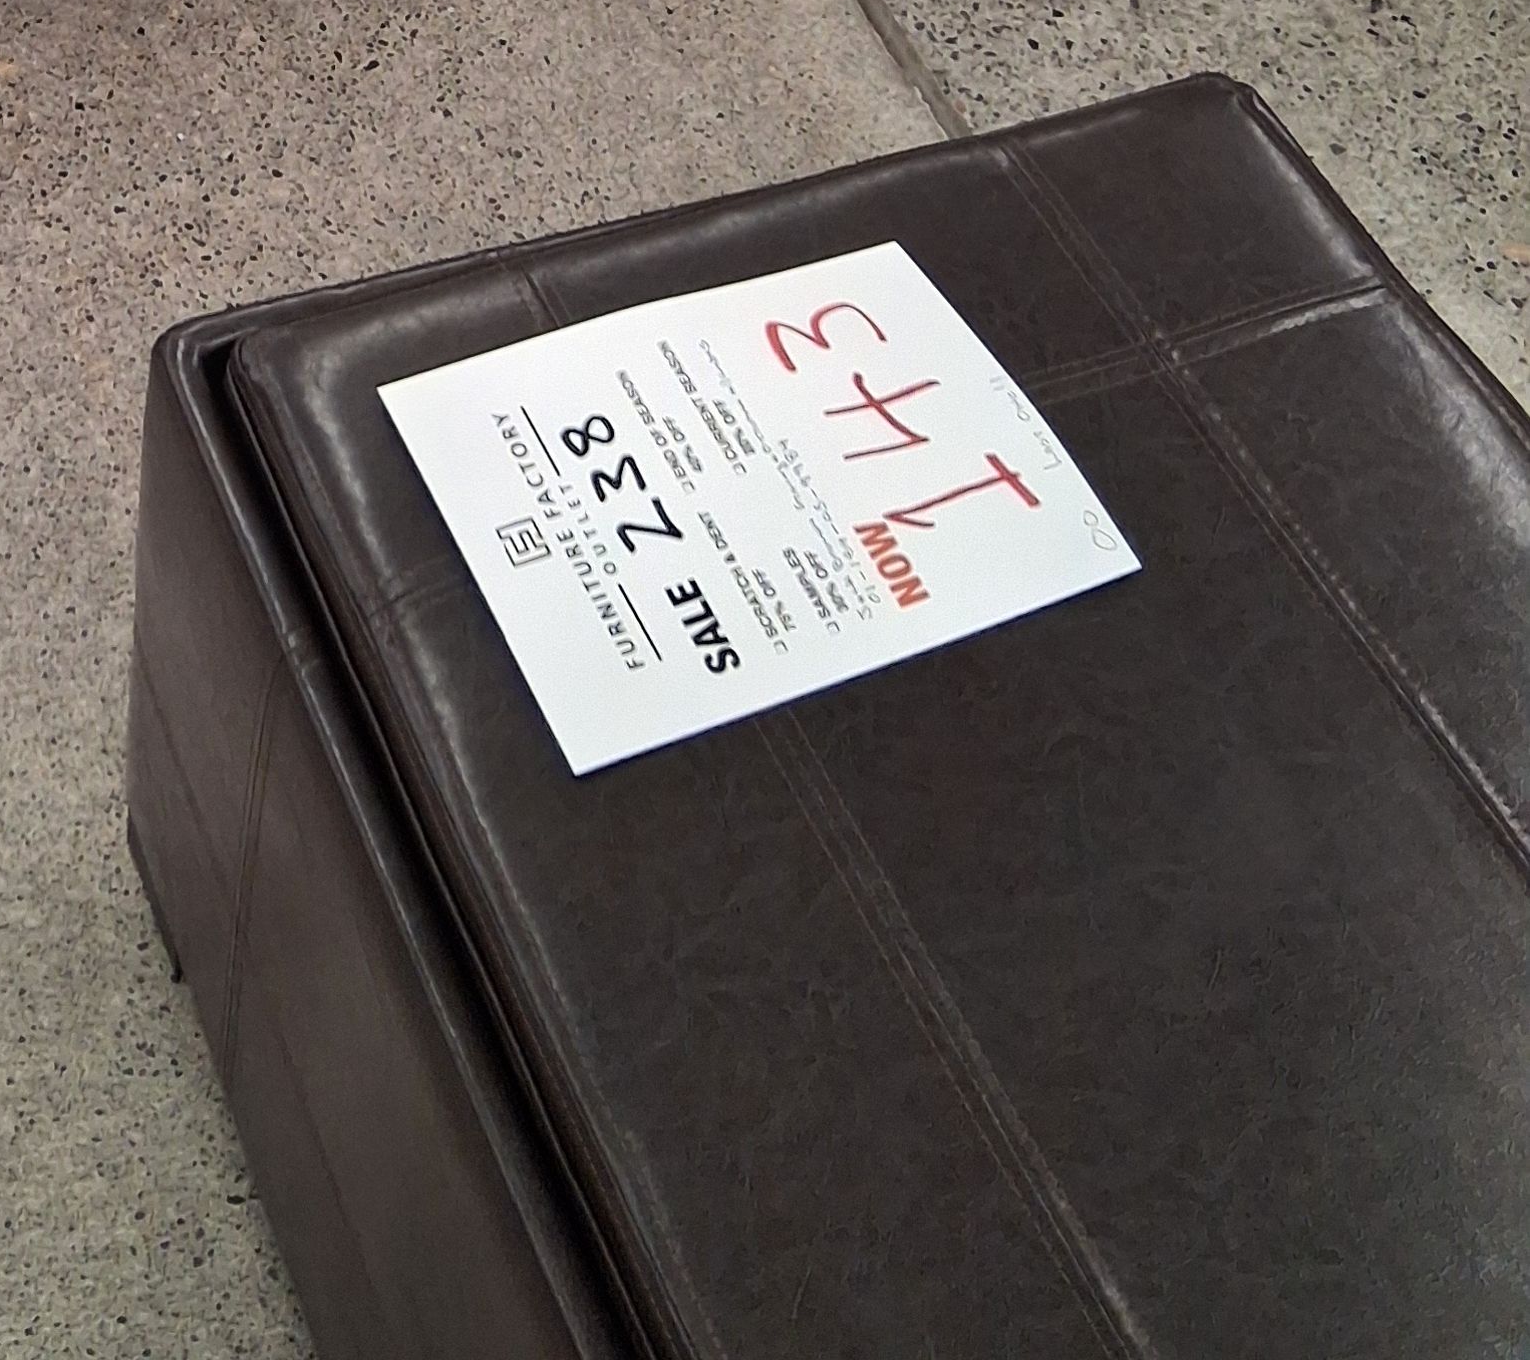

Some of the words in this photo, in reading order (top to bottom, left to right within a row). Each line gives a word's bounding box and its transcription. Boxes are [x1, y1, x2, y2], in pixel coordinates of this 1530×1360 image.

[618, 371, 655, 425] SEASON
[660, 342, 697, 395] SEASON
[650, 428, 668, 447] OF
[662, 416, 686, 442] OFF
[691, 398, 738, 461] CURRENT
[713, 400, 736, 425] OFF
[765, 303, 1040, 528] 143
[492, 415, 561, 519] FACTORY
[561, 416, 683, 553] 238
[664, 449, 687, 479] END
[559, 485, 617, 575] OUTLET
[698, 512, 728, 550] DENT
[752, 569, 776, 599] OFF
[783, 548, 831, 618] SAMPLES
[804, 552, 828, 579] OFF
[853, 522, 930, 608] NOW
[556, 529, 645, 670] FURNITURE
[665, 579, 740, 673] SALE
[731, 566, 778, 638] SCRATCH
